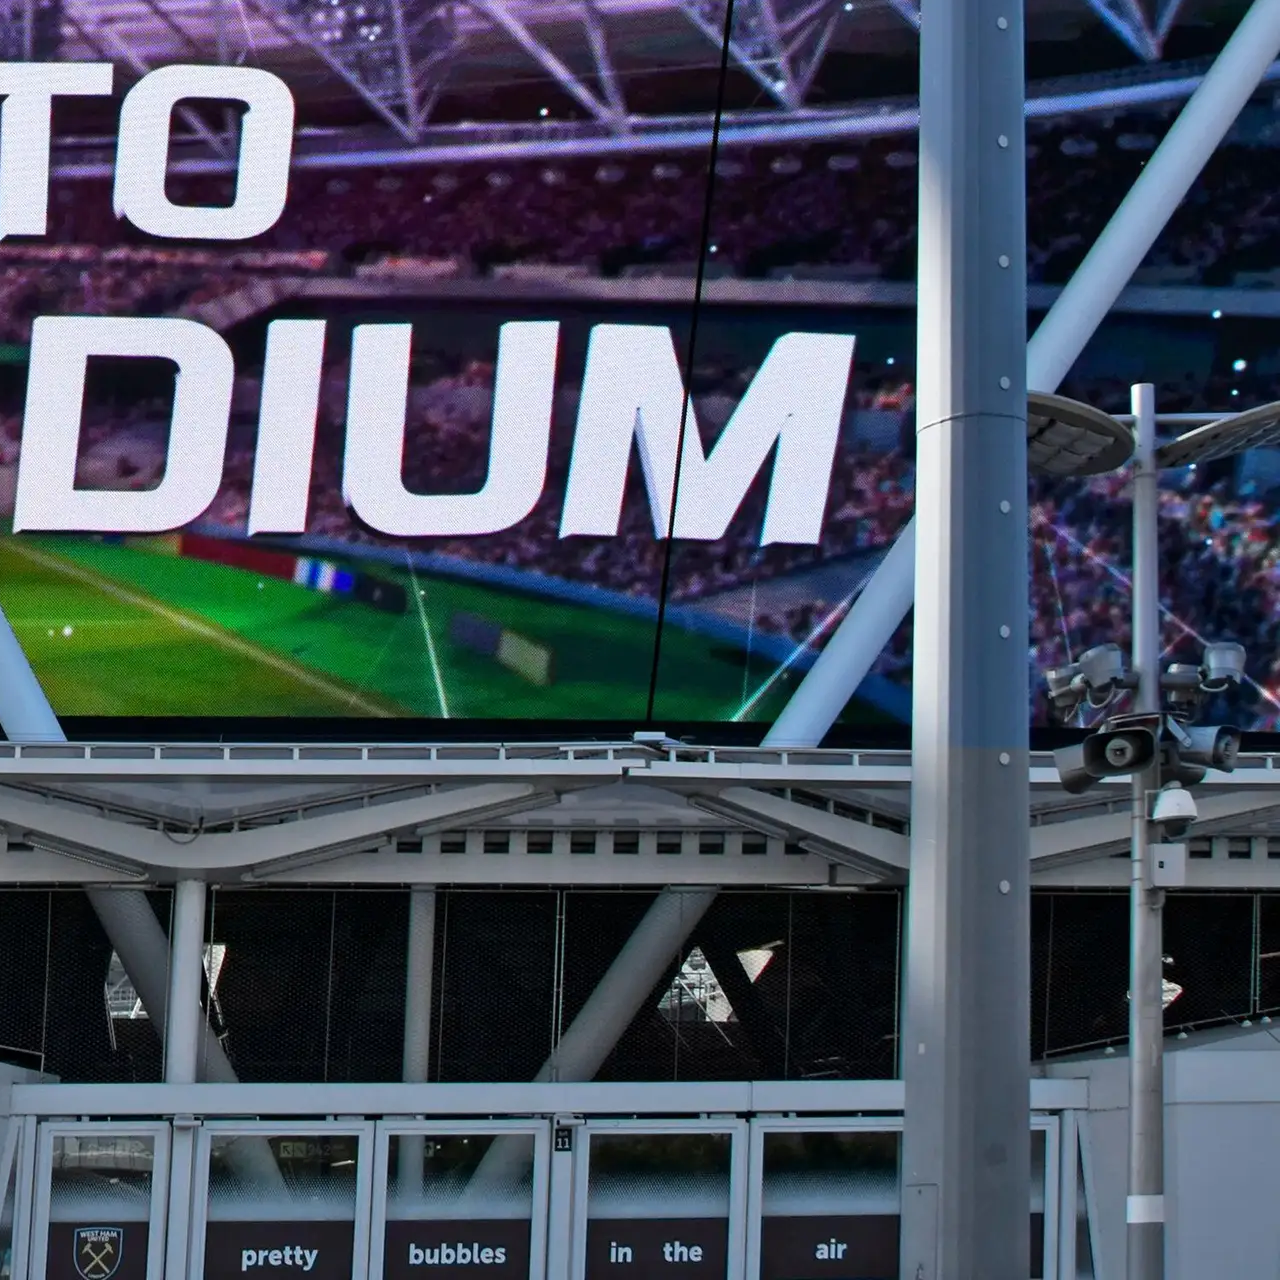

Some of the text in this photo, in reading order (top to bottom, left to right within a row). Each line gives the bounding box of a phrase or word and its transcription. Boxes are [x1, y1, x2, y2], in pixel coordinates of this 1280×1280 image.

[556, 1137, 570, 1149] 11
[242, 1245, 318, 1271] pretty
[409, 1243, 507, 1265] bubbles
[610, 1241, 703, 1263] in the
[815, 1238, 848, 1259] air
